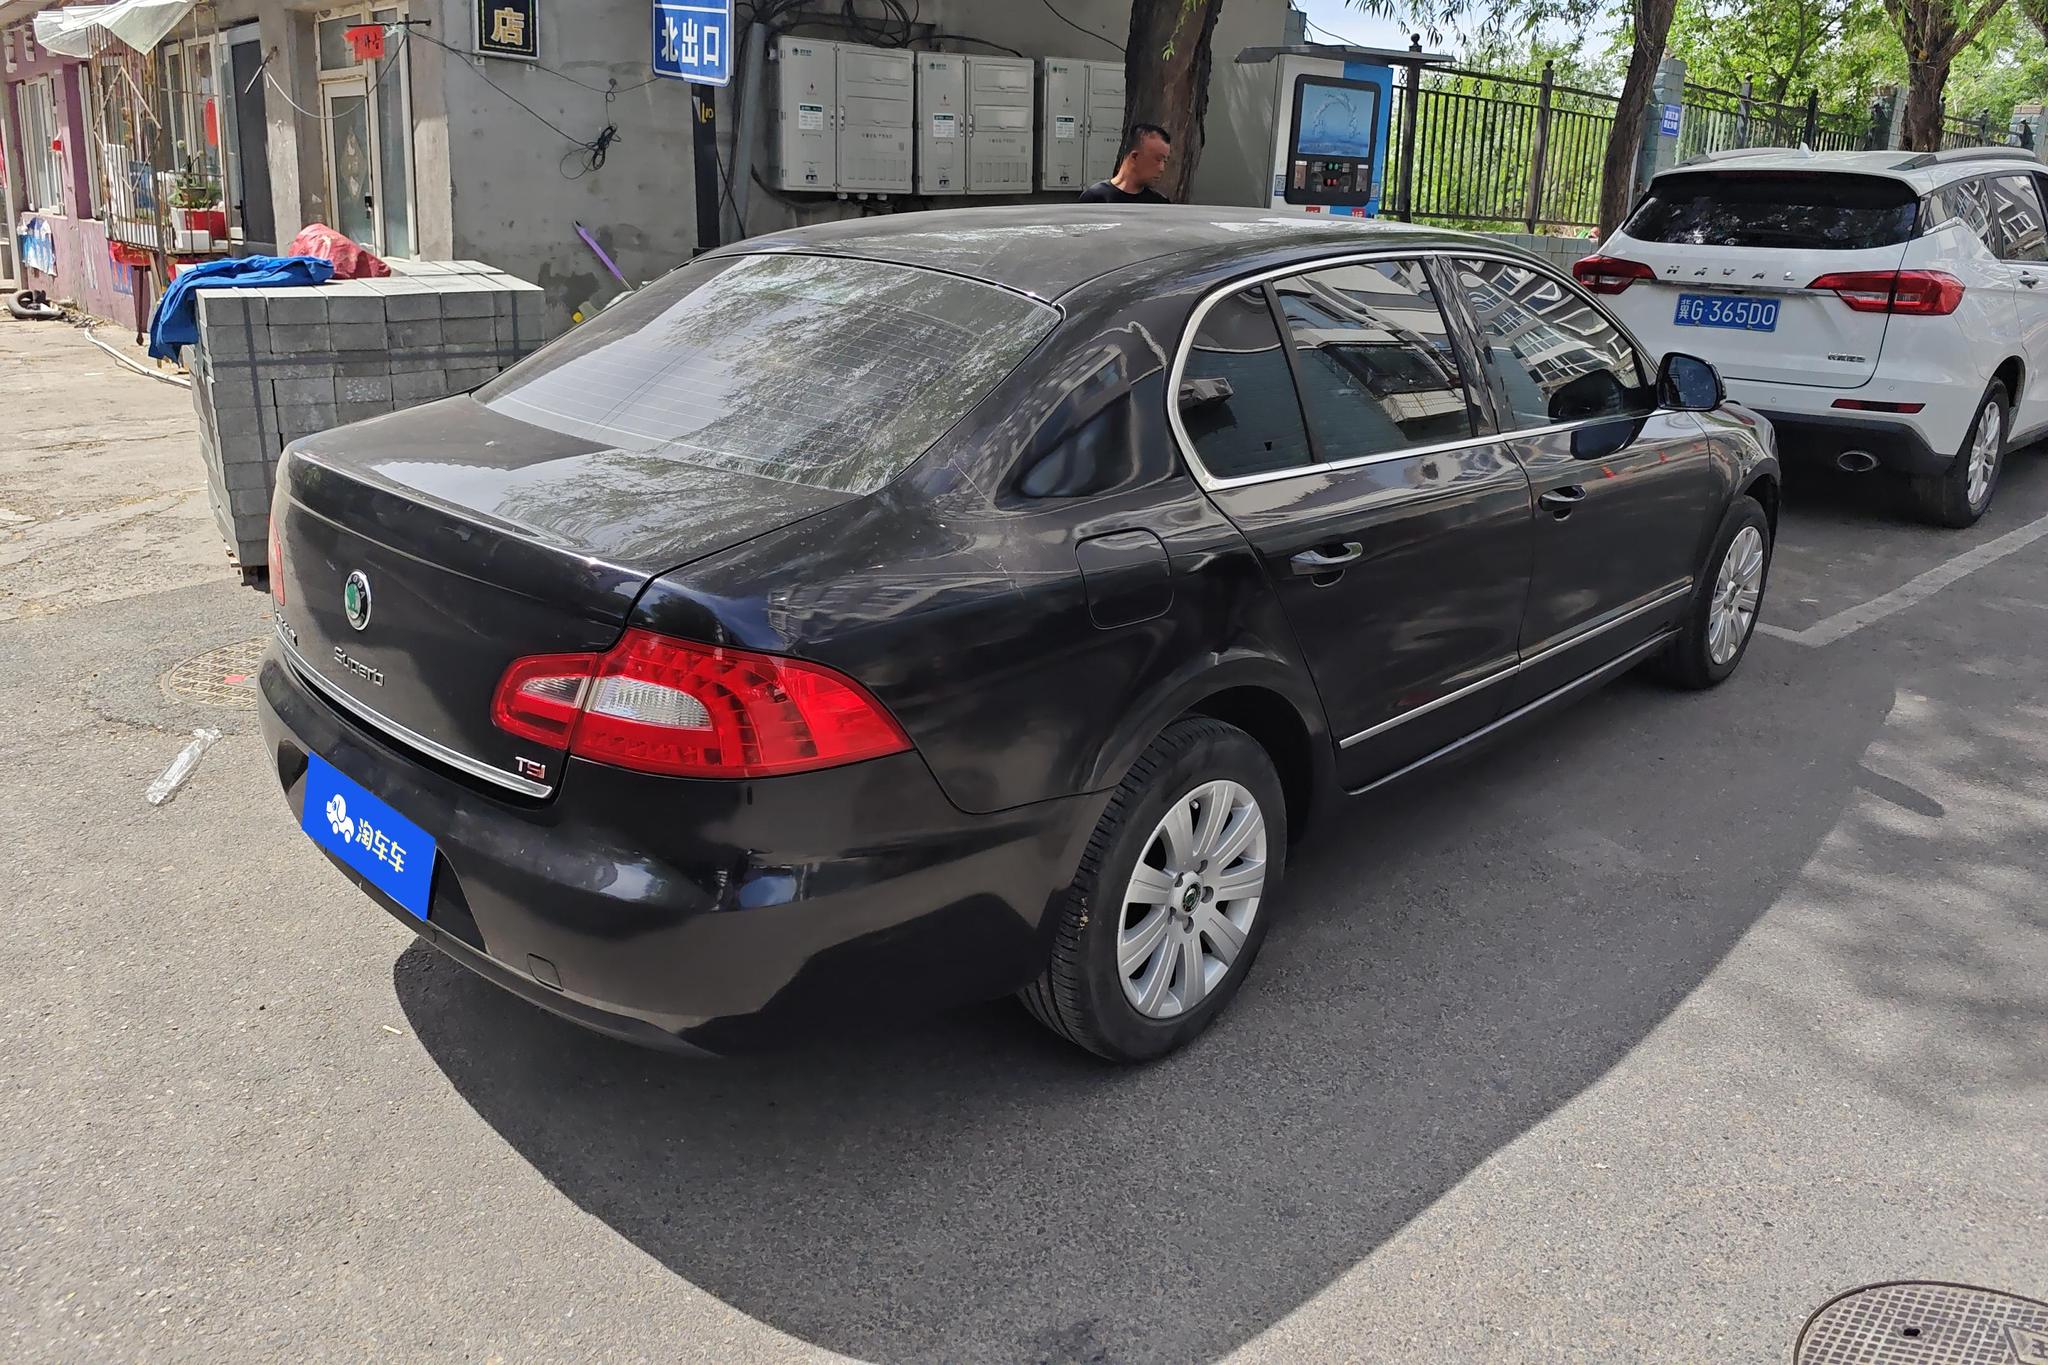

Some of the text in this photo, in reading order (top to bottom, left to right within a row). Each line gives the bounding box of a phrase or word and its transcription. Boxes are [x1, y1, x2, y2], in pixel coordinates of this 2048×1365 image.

[491, 7, 525, 46] 店
[661, 16, 720, 67] 北出口
[1667, 265, 1796, 281] HAVAL
[334, 646, 385, 687] Superb
[515, 756, 546, 780] TSI
